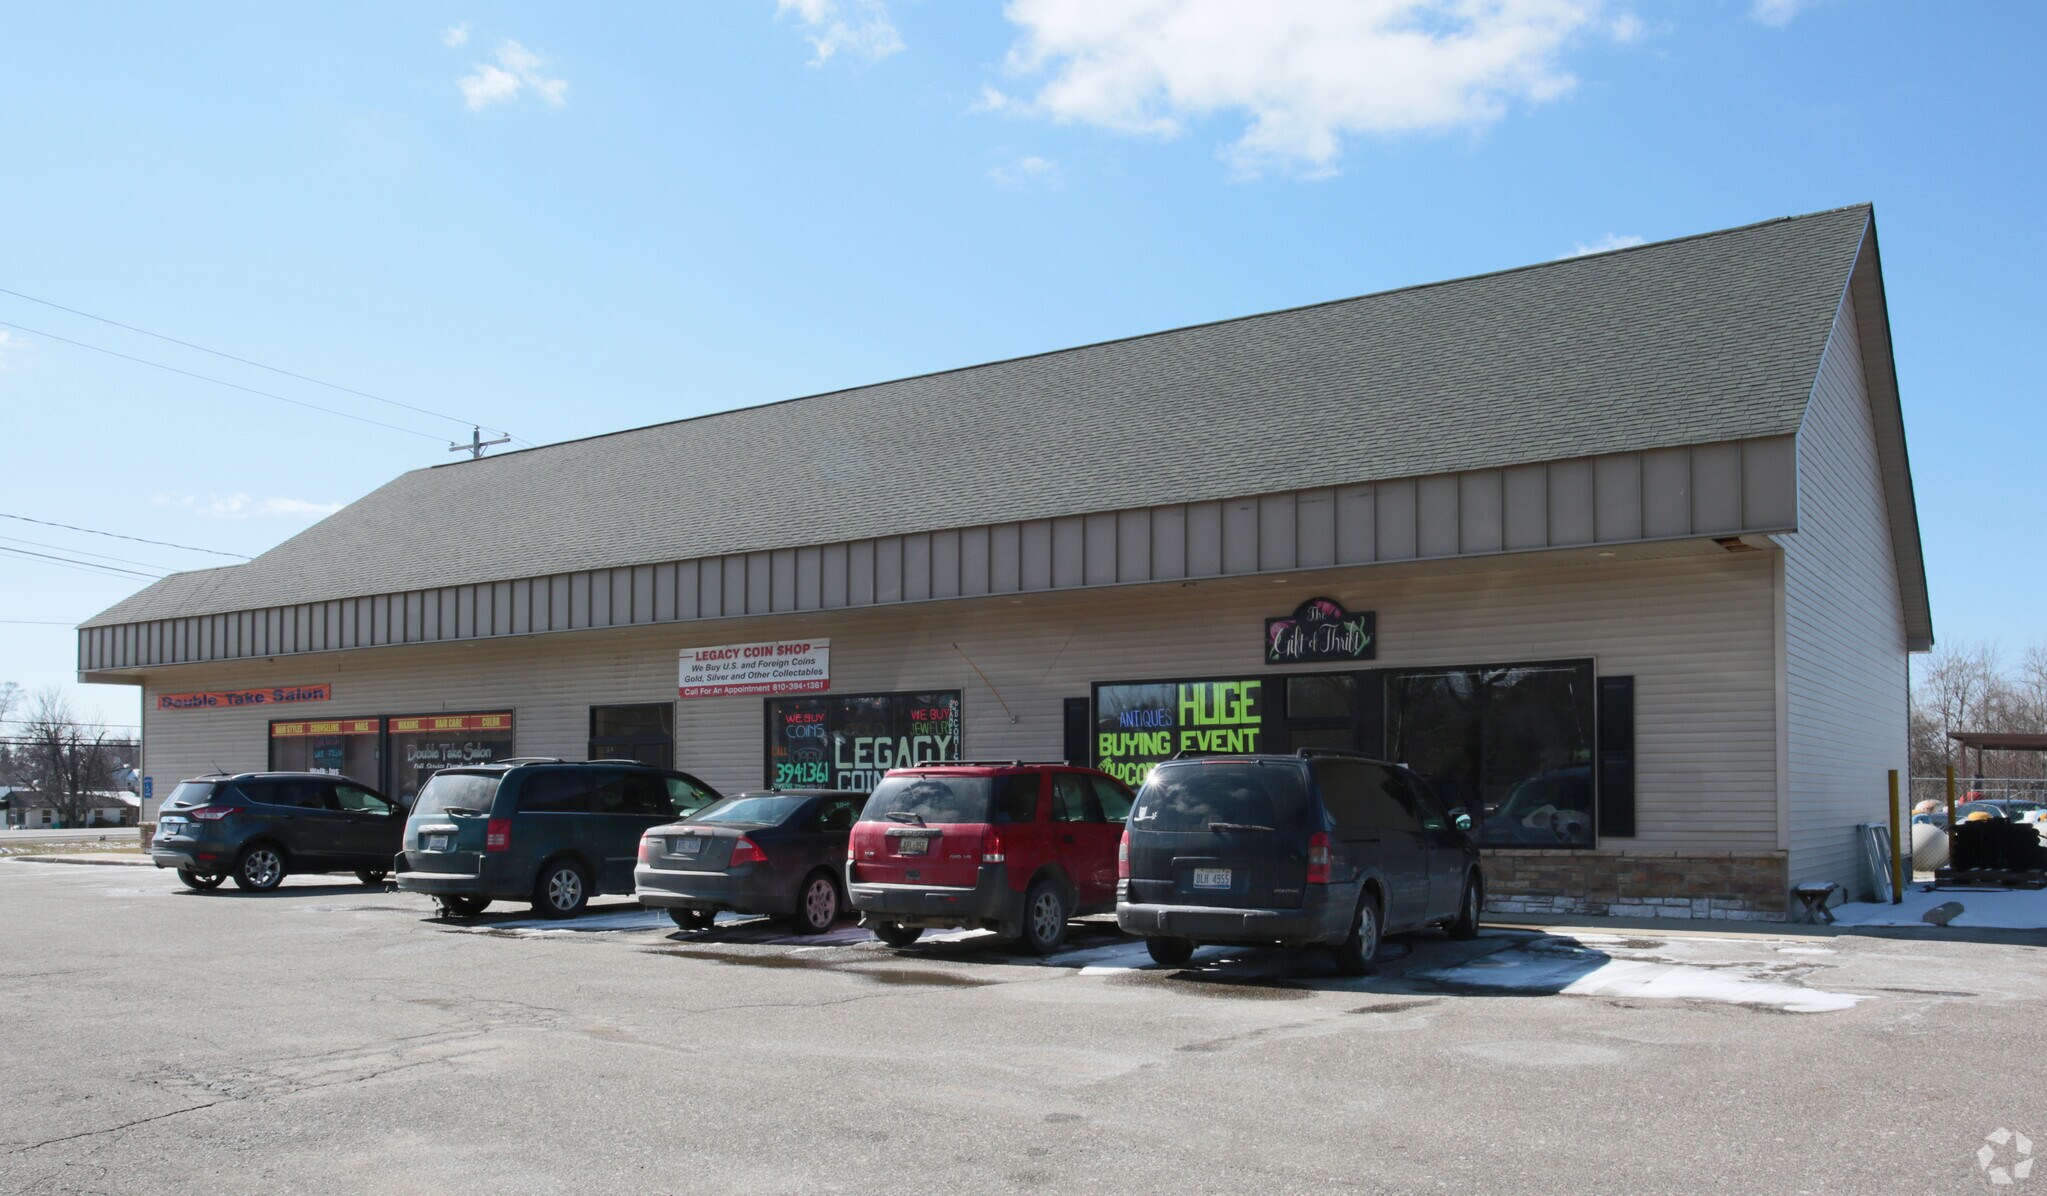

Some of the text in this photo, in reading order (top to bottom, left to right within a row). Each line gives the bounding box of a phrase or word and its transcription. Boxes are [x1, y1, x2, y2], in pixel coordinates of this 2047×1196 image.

[1307, 606, 1325, 621] The
[1274, 625, 1304, 658] Gift
[1320, 620, 1360, 653] Thrift
[696, 644, 811, 661] LEGACY COIN SHOP
[692, 658, 816, 672] We Buy U.S. and Foreign Coins
[684, 668, 823, 683] Gold, Silver and Other Collectables
[684, 688, 698, 696] Call
[700, 687, 711, 695] For
[713, 686, 722, 694] An
[724, 684, 770, 694] Appointment
[162, 688, 324, 708] Double Take Salon
[1179, 680, 1261, 726] HUGE
[786, 713, 825, 722] WE BUY
[911, 708, 950, 720] WE BUY
[1120, 708, 1172, 728] ANTIQUES
[435, 718, 462, 728] HAIR CARE
[786, 724, 825, 738] COINS
[1099, 728, 1260, 756] BUYING EVENT
[407, 742, 492, 762] Double Take Salon
[835, 735, 952, 769] LEGACY
[1212, 874, 1229, 885] 4955
